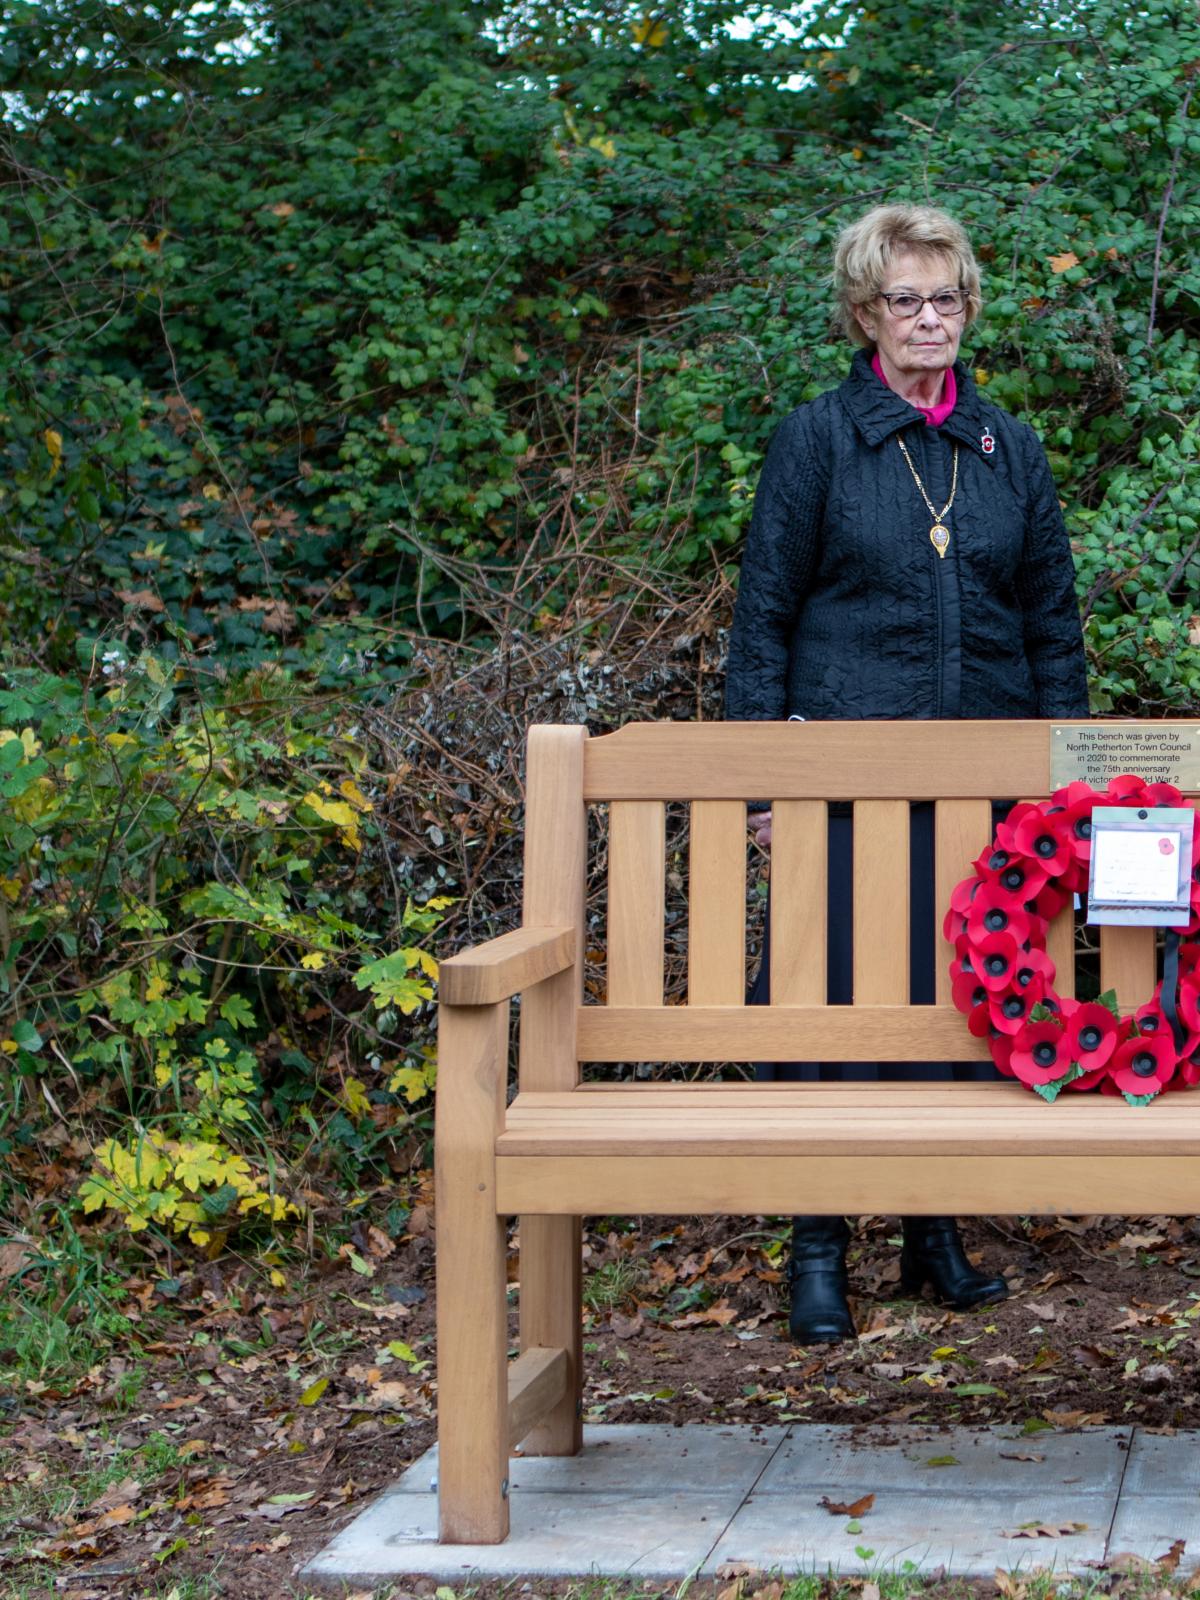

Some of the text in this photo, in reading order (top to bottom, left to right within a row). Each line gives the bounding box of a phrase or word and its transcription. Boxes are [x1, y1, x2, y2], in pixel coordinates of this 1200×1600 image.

[1078, 732, 1096, 740] This
[1098, 732, 1124, 740] bench
[1144, 733, 1167, 742] given
[1169, 732, 1180, 742] by
[1066, 743, 1192, 751] North Petherton Town Council
[1077, 754, 1181, 762] in 2020 to commemorate
[1103, 764, 1121, 773] 75th
[1122, 765, 1171, 774] anniversary
[1088, 776, 1113, 784] victor
[1155, 775, 1172, 783] War
[1174, 775, 1180, 783] 2
